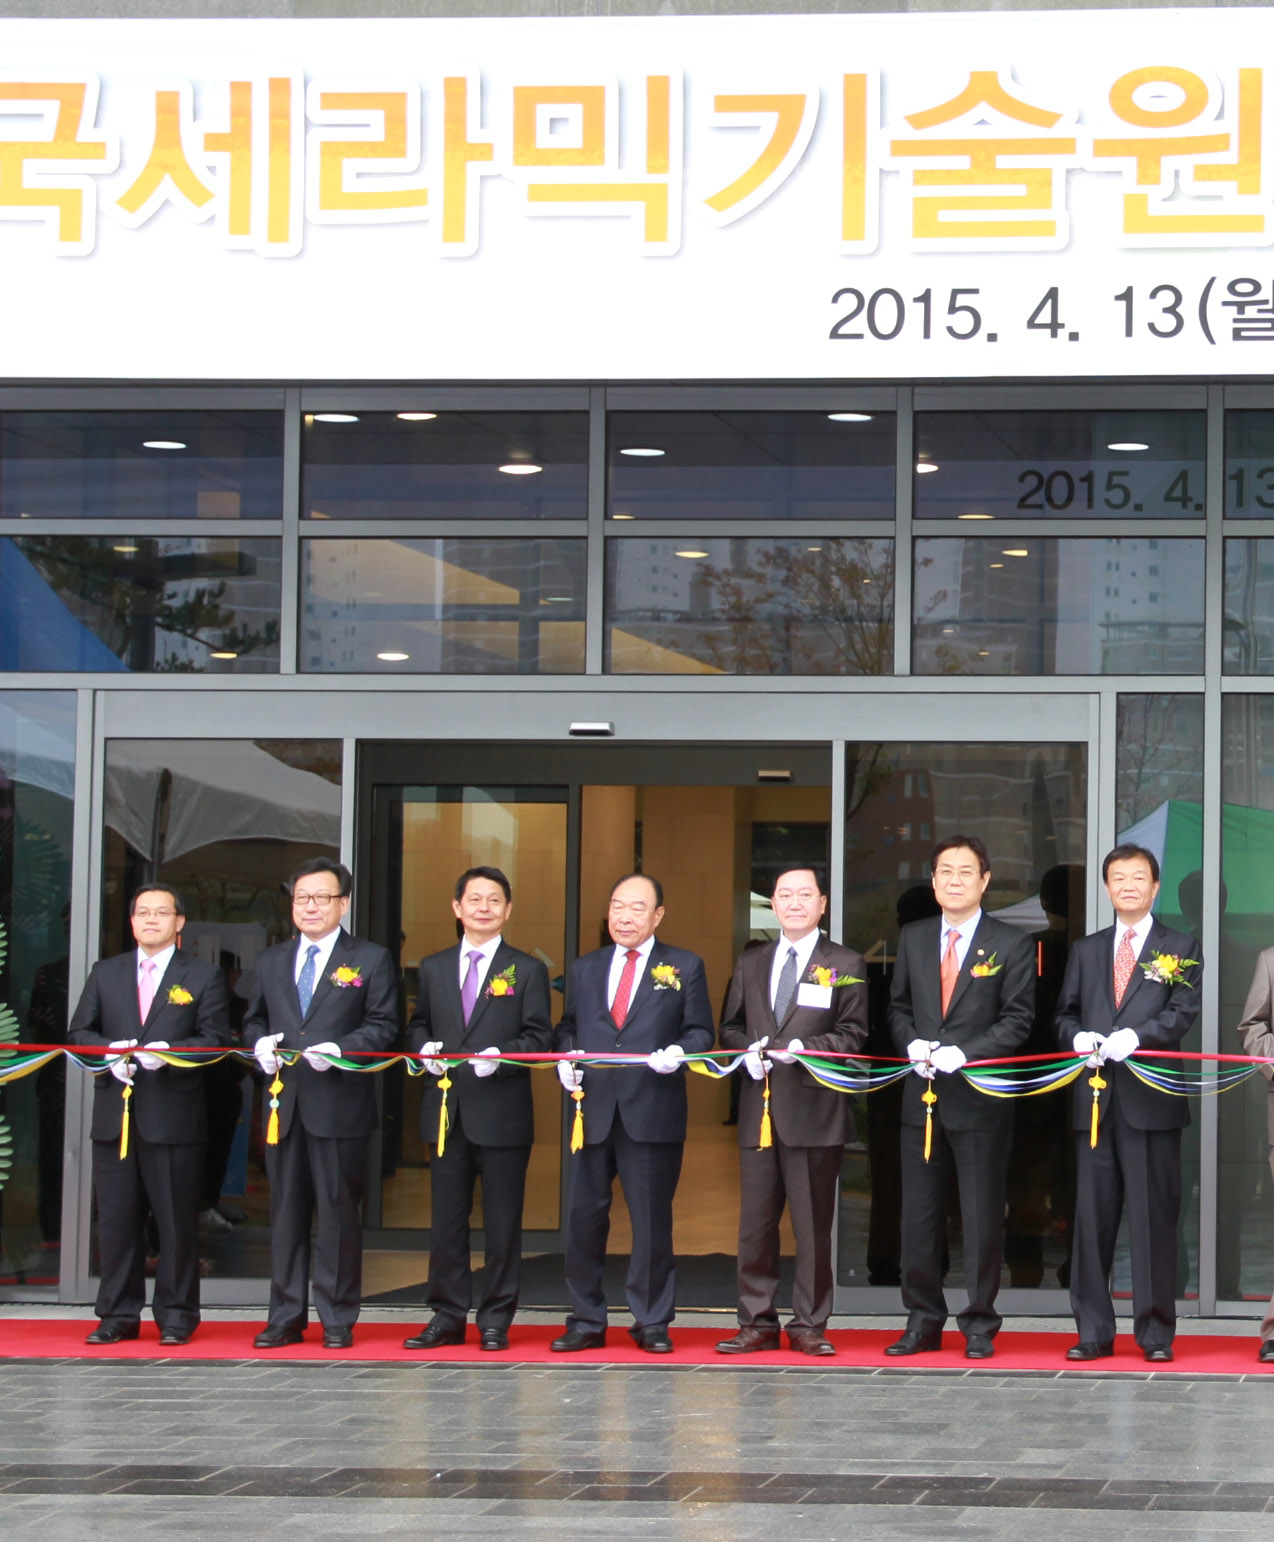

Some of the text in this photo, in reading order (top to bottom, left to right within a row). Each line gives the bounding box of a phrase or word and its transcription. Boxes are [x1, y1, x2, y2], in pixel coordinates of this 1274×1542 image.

[829, 287, 998, 342] 2015.
[1026, 286, 1080, 342] 4.
[1016, 468, 1144, 513] 2015.
[1163, 469, 1205, 512] 4.
